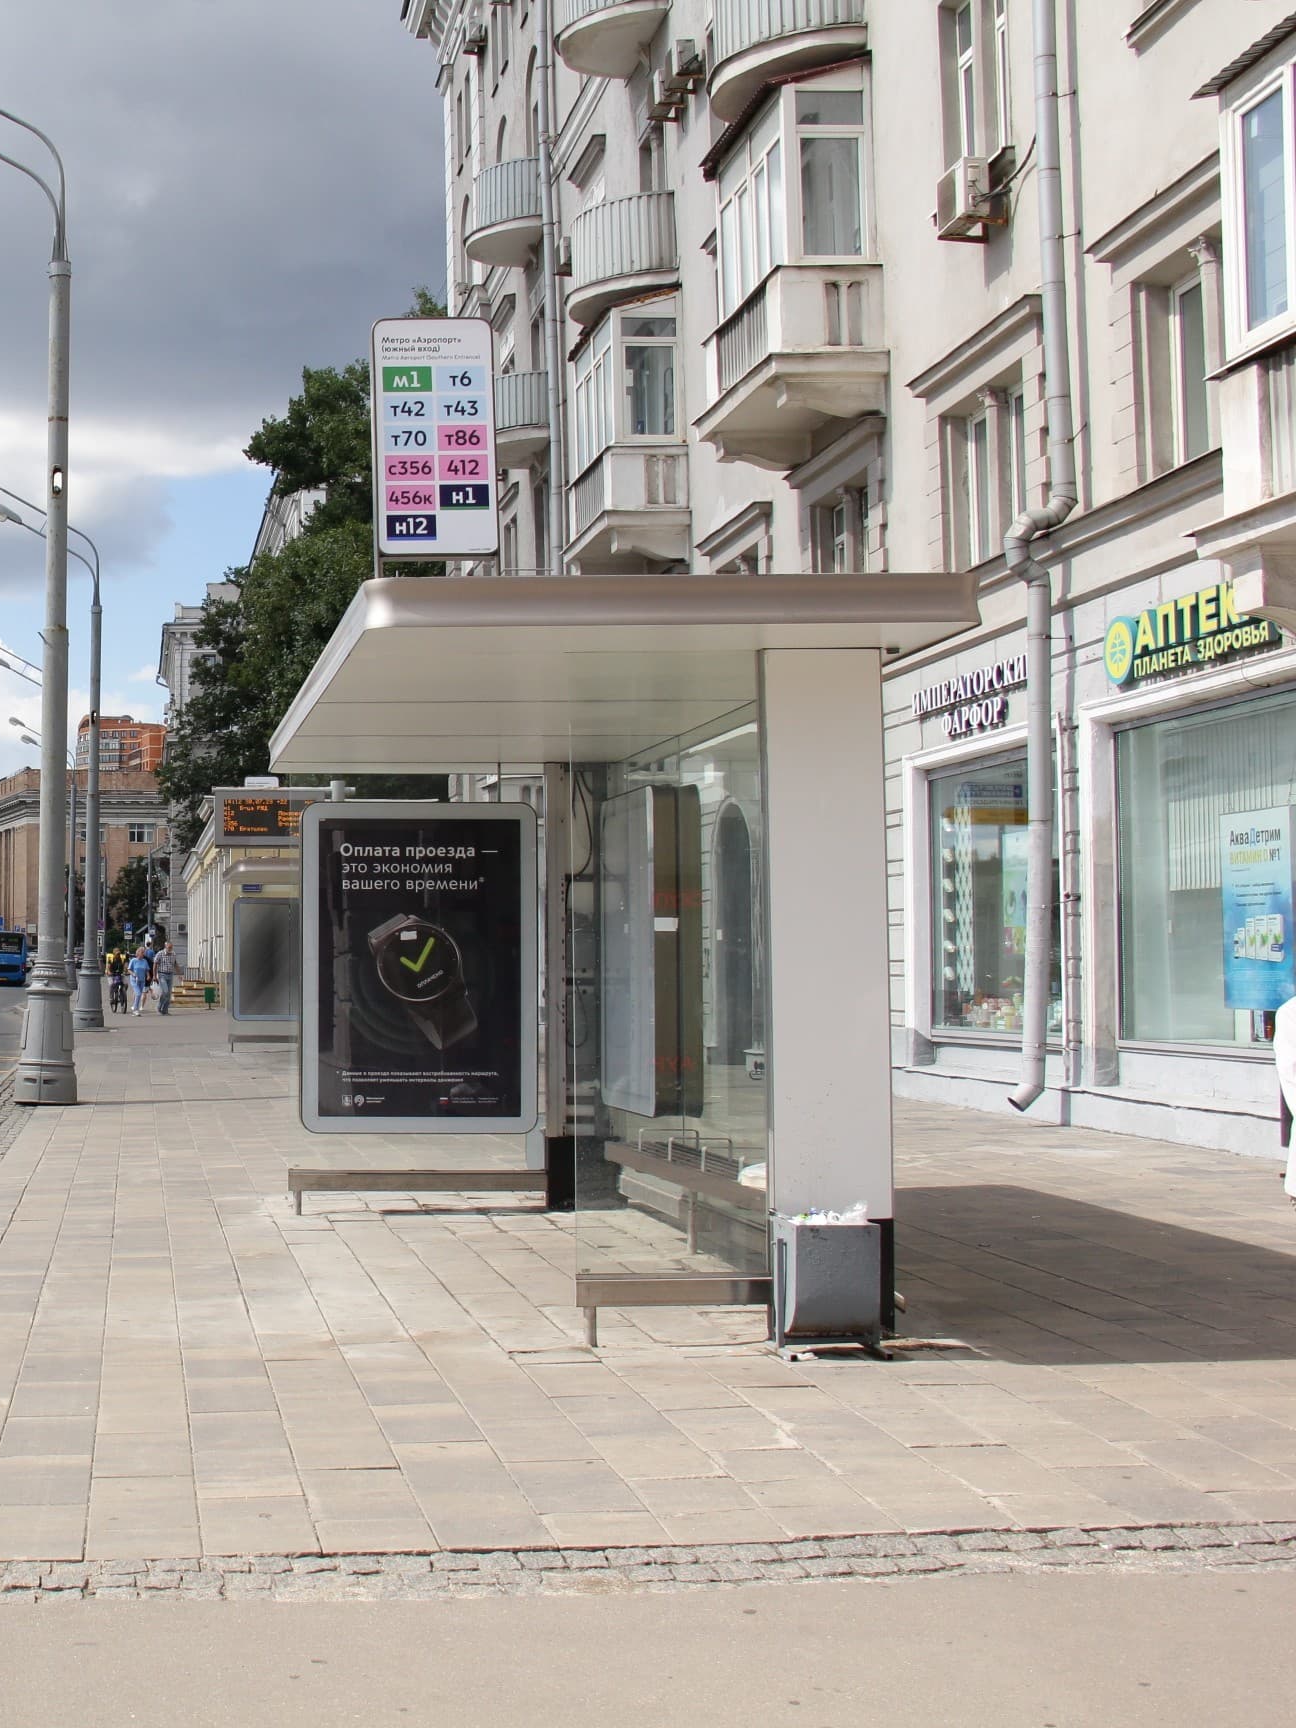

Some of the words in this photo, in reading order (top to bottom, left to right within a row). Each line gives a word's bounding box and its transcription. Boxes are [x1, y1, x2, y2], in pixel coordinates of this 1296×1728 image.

[381, 336, 410, 345] Метро
[412, 336, 462, 345] «Аэропорт»
[381, 345, 416, 353] (южный
[418, 345, 441, 353] вход)
[393, 371, 421, 388] м1
[449, 370, 472, 387] т6
[390, 401, 426, 417] т42
[444, 400, 479, 416] т43
[391, 431, 427, 447] т70
[444, 430, 481, 446] т86
[388, 460, 432, 476] с356
[447, 459, 480, 476] 412
[389, 490, 433, 506] 456к
[452, 487, 476, 504] н1
[395, 518, 428, 535] н12
[1134, 581, 1250, 655] АПТЕК
[1133, 646, 1192, 678] ПЛАНЕТА
[1197, 621, 1269, 661] ЗДОРОВЬЯ
[912, 653, 1028, 716] ИМПЕРАТОРСКИ
[941, 697, 1002, 737] ФАРФОР
[1229, 827, 1281, 846] АкваДетрим
[340, 843, 401, 857] Оплата
[405, 846, 476, 860] проезда
[342, 862, 368, 874] это
[373, 862, 453, 874] экономия
[342, 879, 401, 891] вашего
